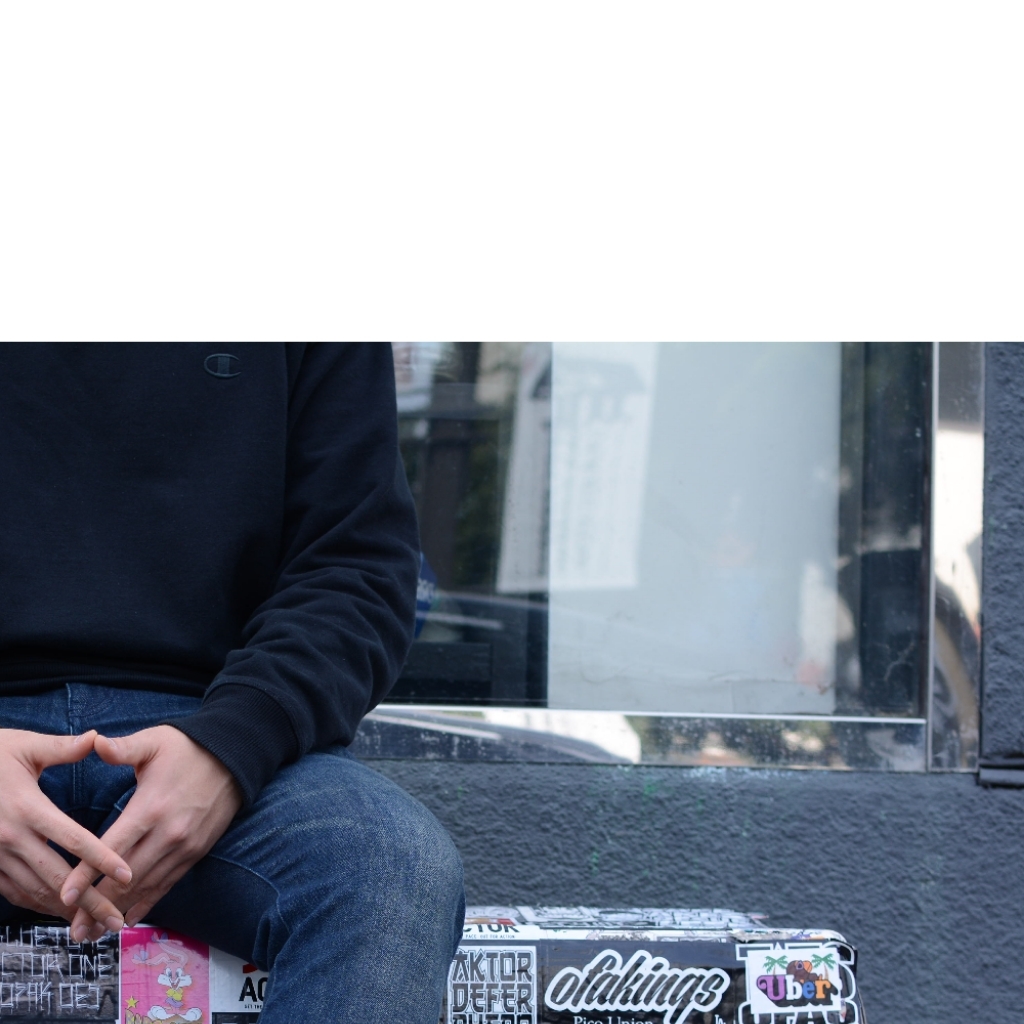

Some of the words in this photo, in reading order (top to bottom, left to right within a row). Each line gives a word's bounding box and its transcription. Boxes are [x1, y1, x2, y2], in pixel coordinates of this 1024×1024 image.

[452, 951, 534, 983] AKTOR
[452, 983, 534, 1013] DEFER
[756, 974, 832, 1001] Uber
